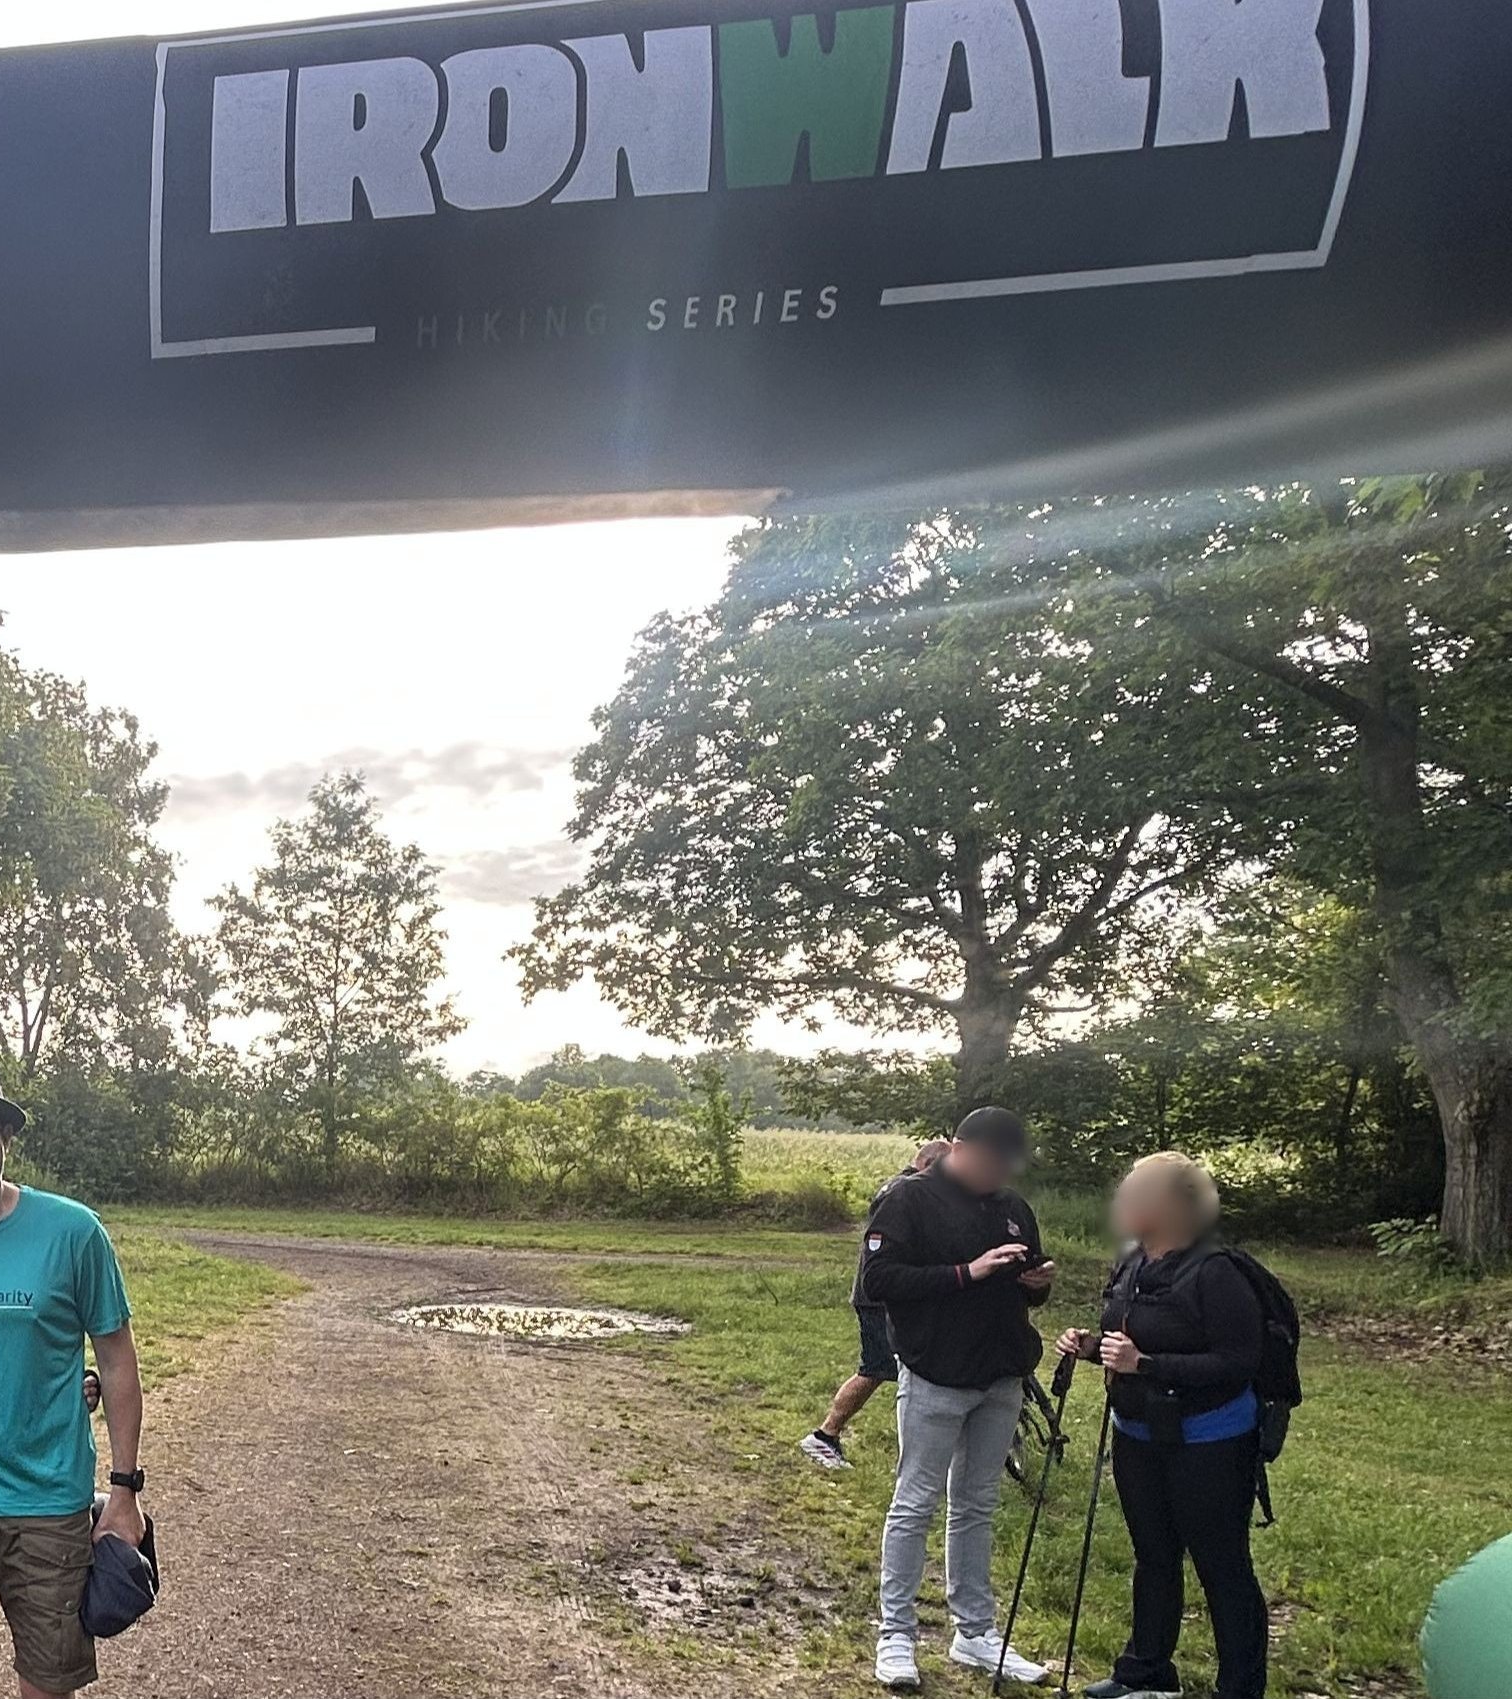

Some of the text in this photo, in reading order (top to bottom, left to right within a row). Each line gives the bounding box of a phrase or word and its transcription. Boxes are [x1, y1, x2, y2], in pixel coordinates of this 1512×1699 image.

[209, 0, 1330, 233] IRONWALK
[417, 286, 840, 348] HIKING SERIES
